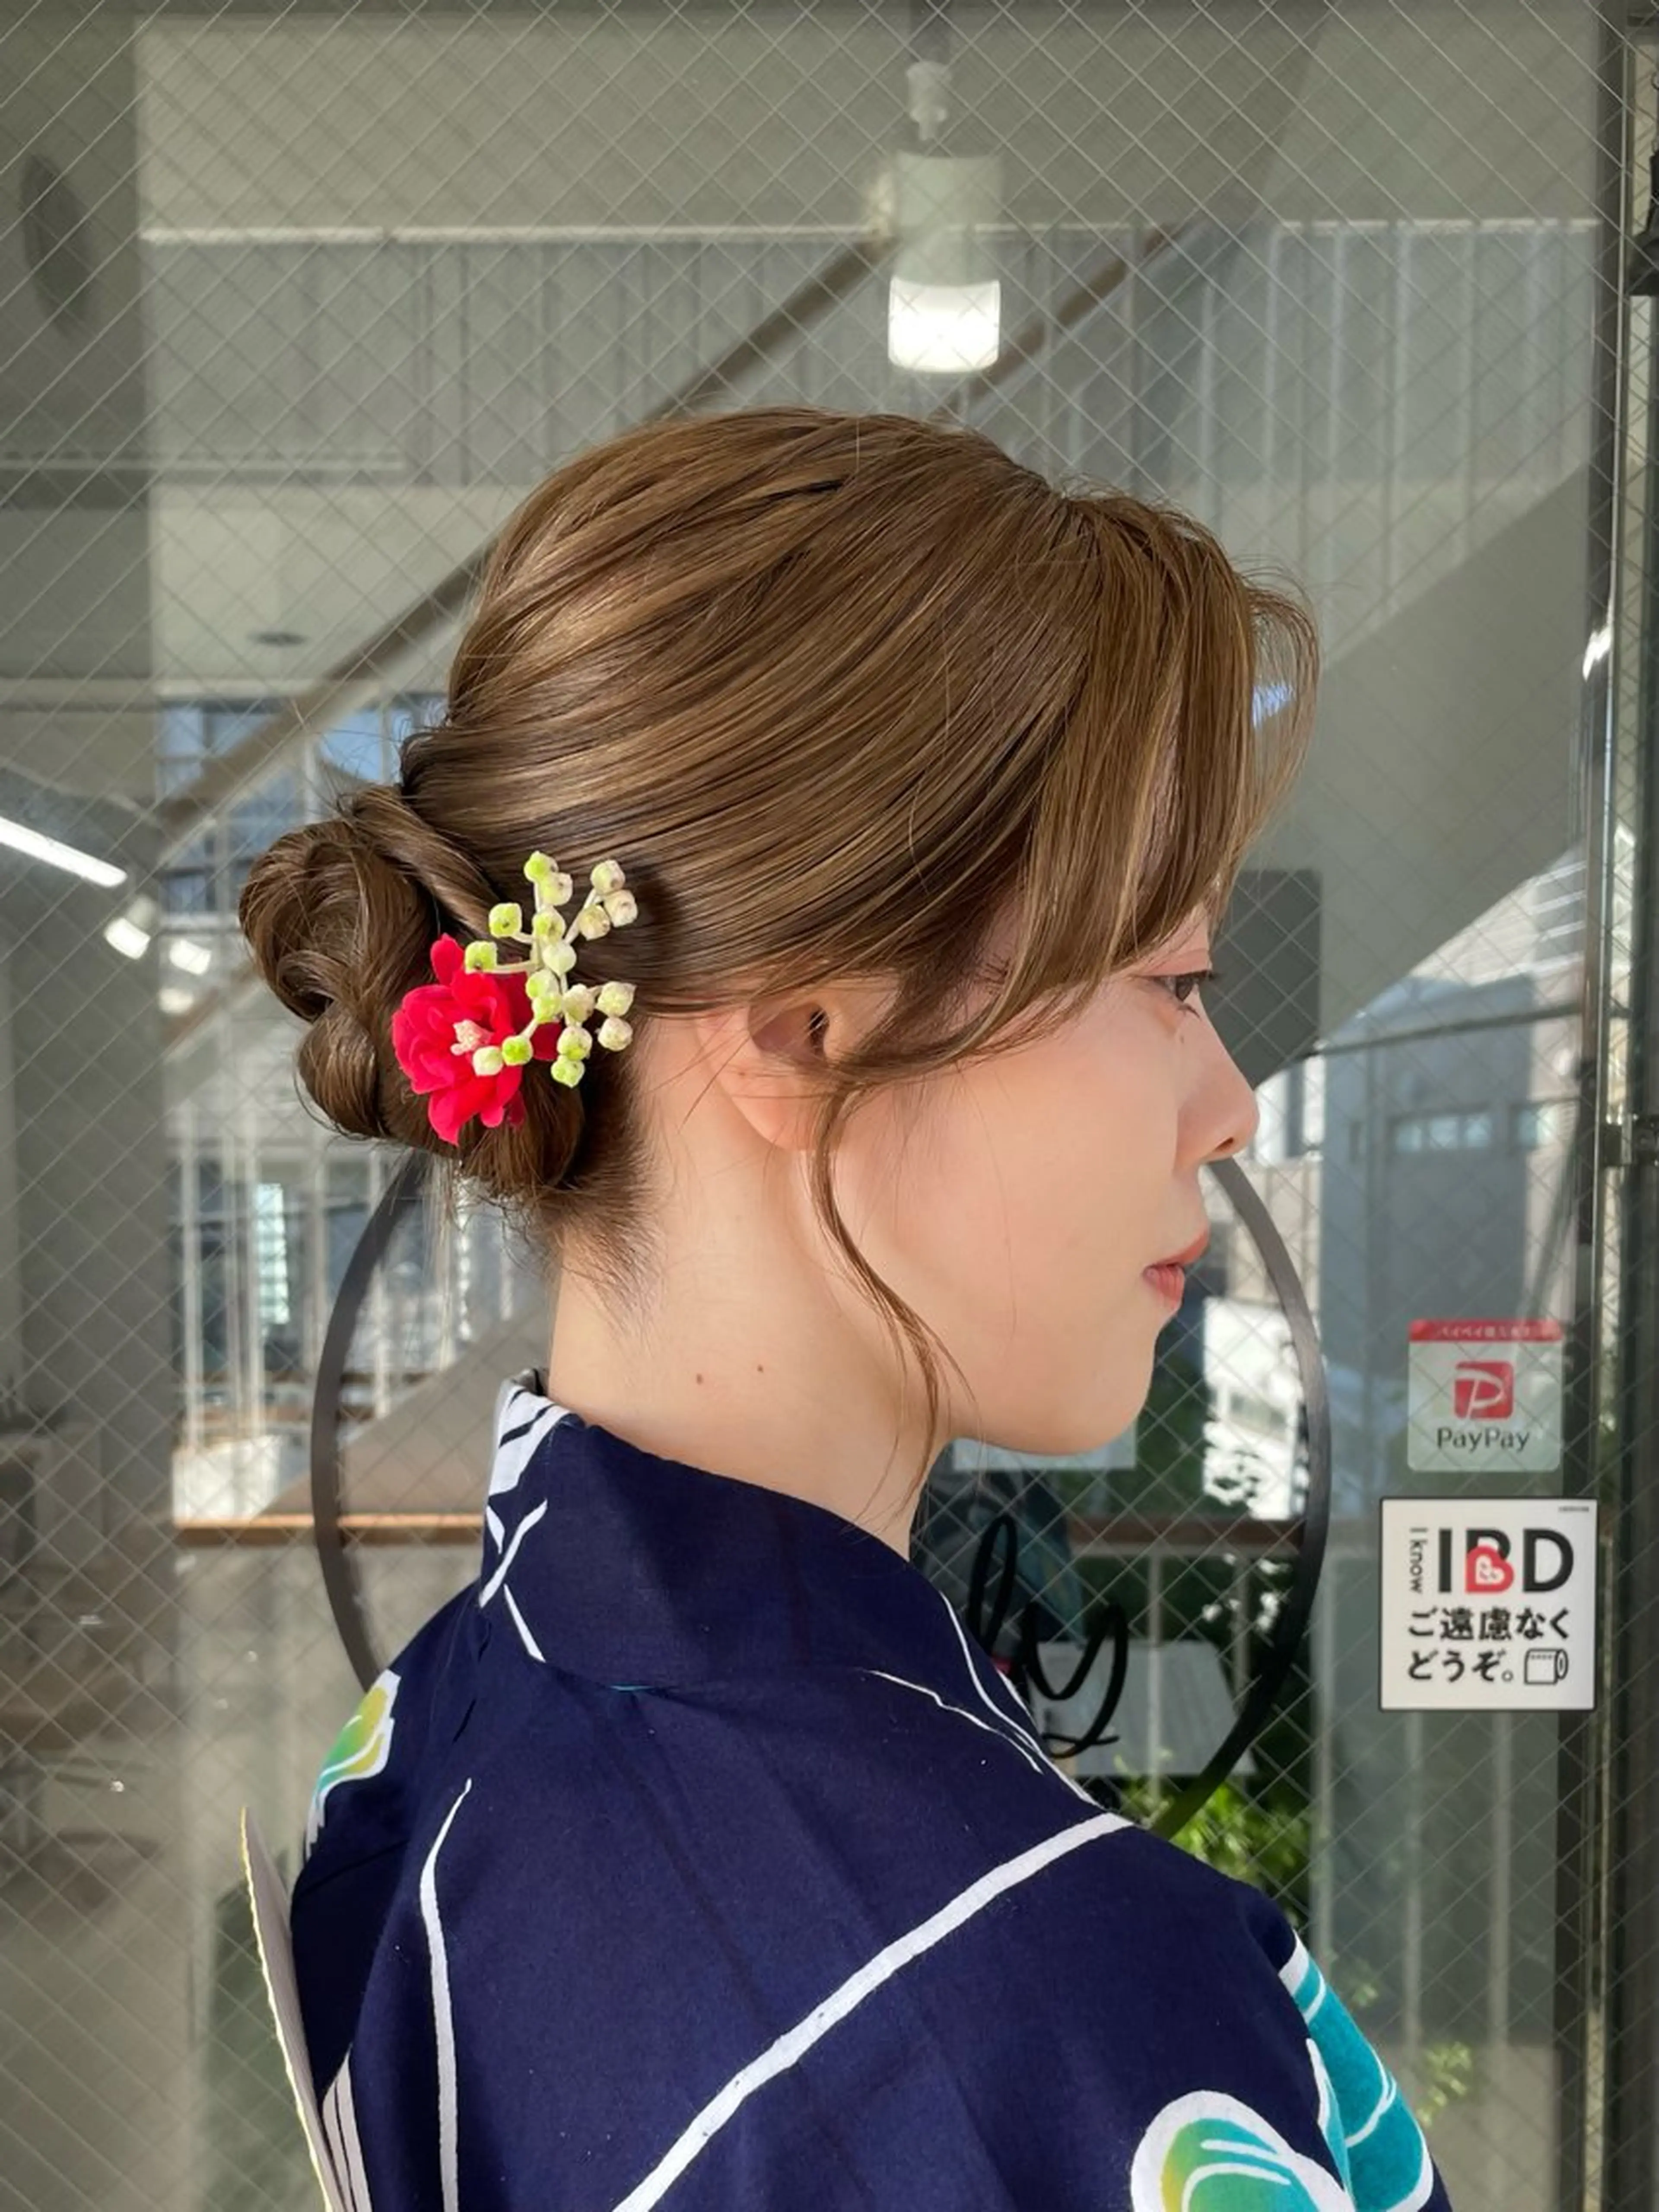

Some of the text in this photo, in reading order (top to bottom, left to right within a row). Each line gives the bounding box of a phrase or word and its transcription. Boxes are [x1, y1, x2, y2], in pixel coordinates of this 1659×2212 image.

[1437, 1427, 1530, 1454] PayPay
[1410, 1539, 1428, 1594] know
[1438, 1528, 1574, 1593] IBD
[1408, 1606, 1569, 1640] ご遠慮なく
[1408, 1648, 1514, 1683] どうぞ。
